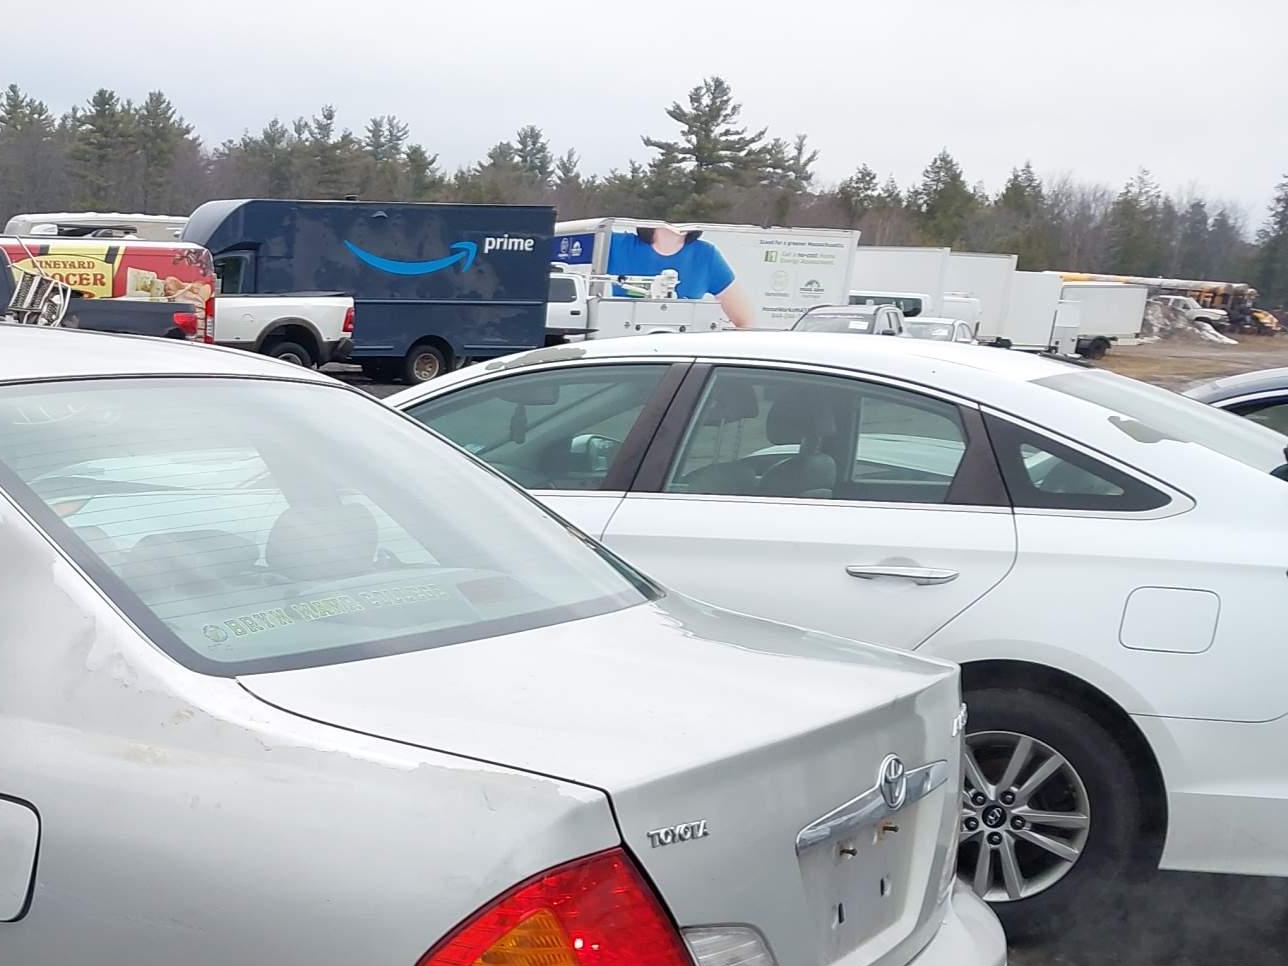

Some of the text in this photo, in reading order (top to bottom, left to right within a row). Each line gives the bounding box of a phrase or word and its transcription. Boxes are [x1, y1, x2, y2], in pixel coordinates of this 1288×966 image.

[483, 233, 535, 254] prime
[31, 259, 96, 269] VINEYARD
[46, 272, 106, 287] OCER
[646, 818, 710, 849] TOYOTA
